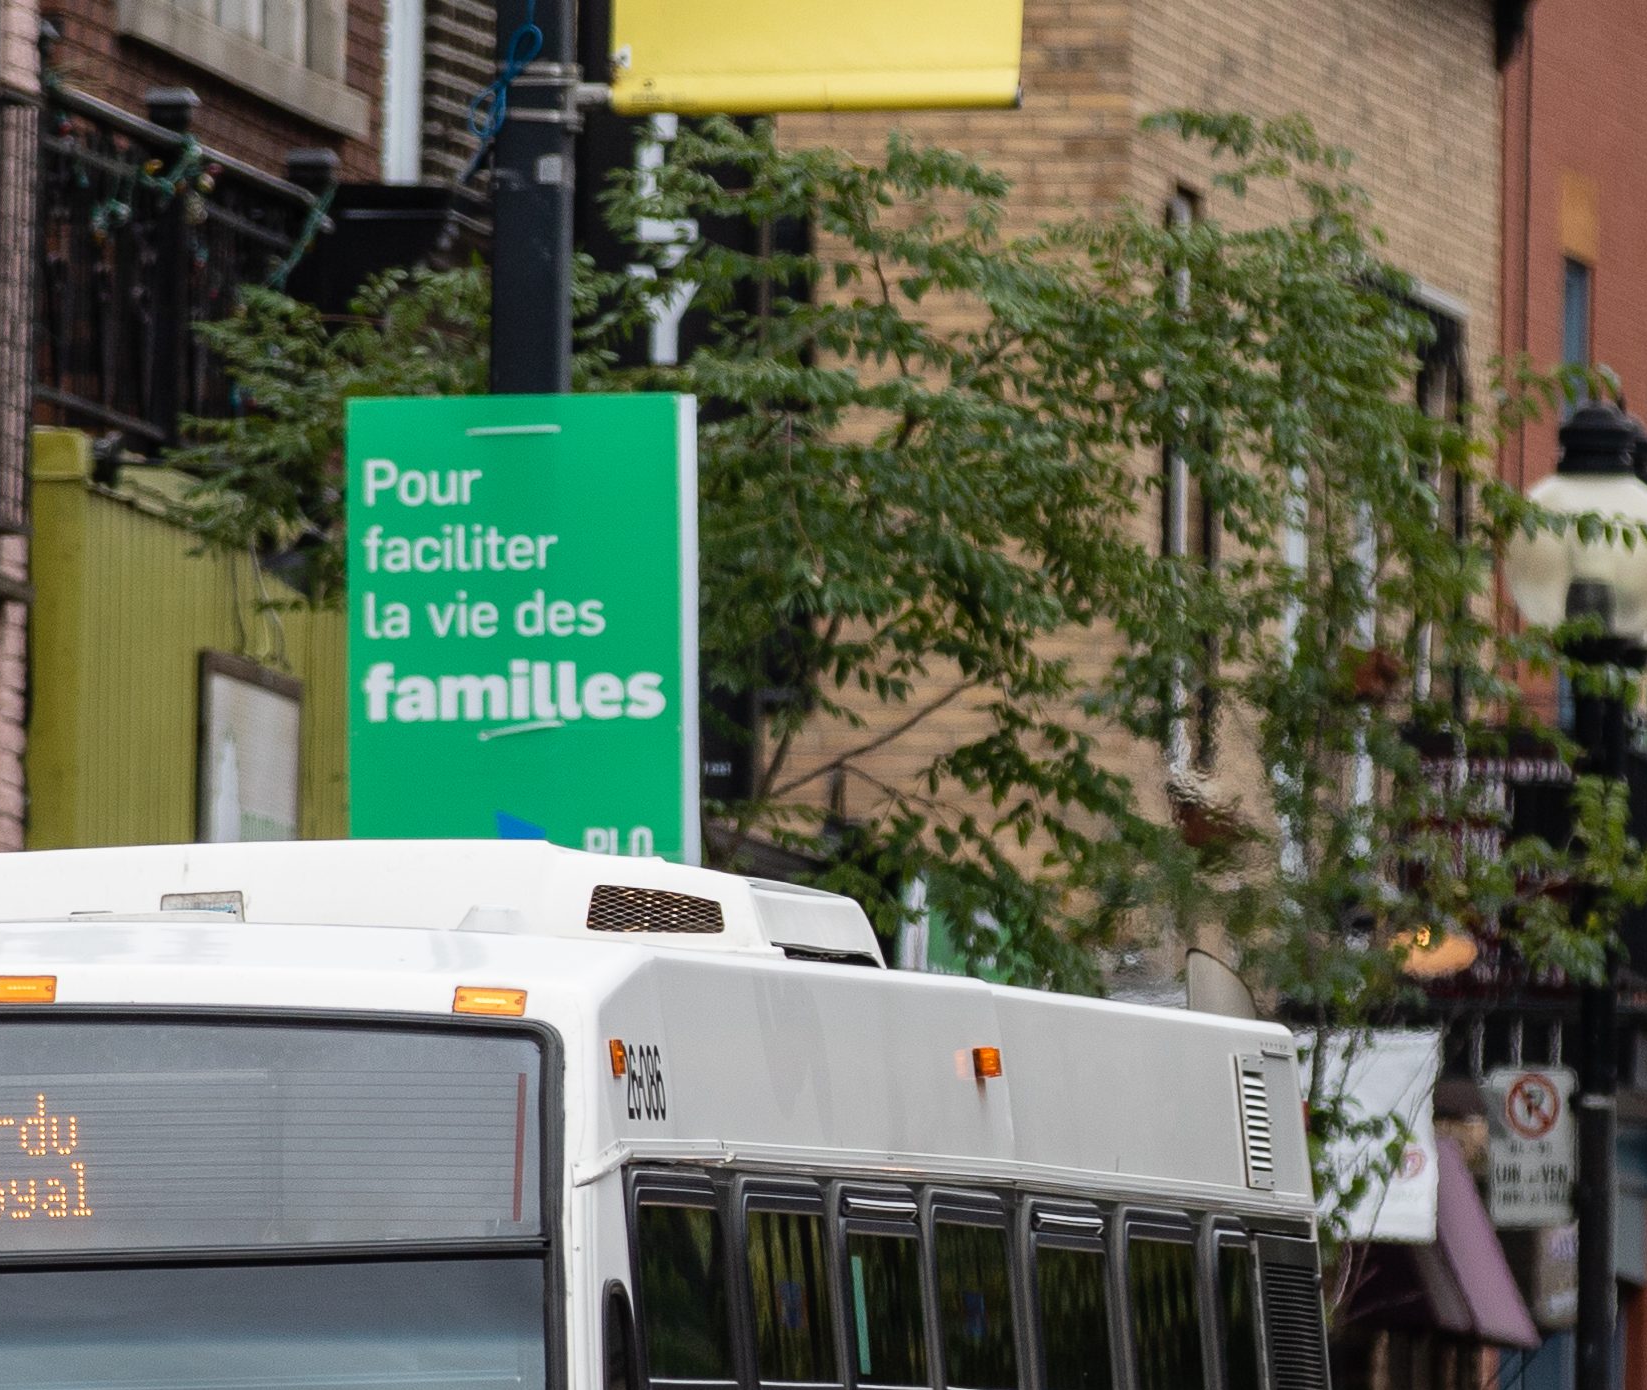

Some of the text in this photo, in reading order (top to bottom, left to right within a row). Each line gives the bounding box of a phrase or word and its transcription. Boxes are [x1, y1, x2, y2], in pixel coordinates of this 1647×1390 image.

[363, 458, 483, 507] Pour
[363, 523, 558, 573] faciliter
[363, 588, 606, 639] la vie des
[363, 658, 667, 722] familles
[620, 1043, 666, 1121] 26-086
